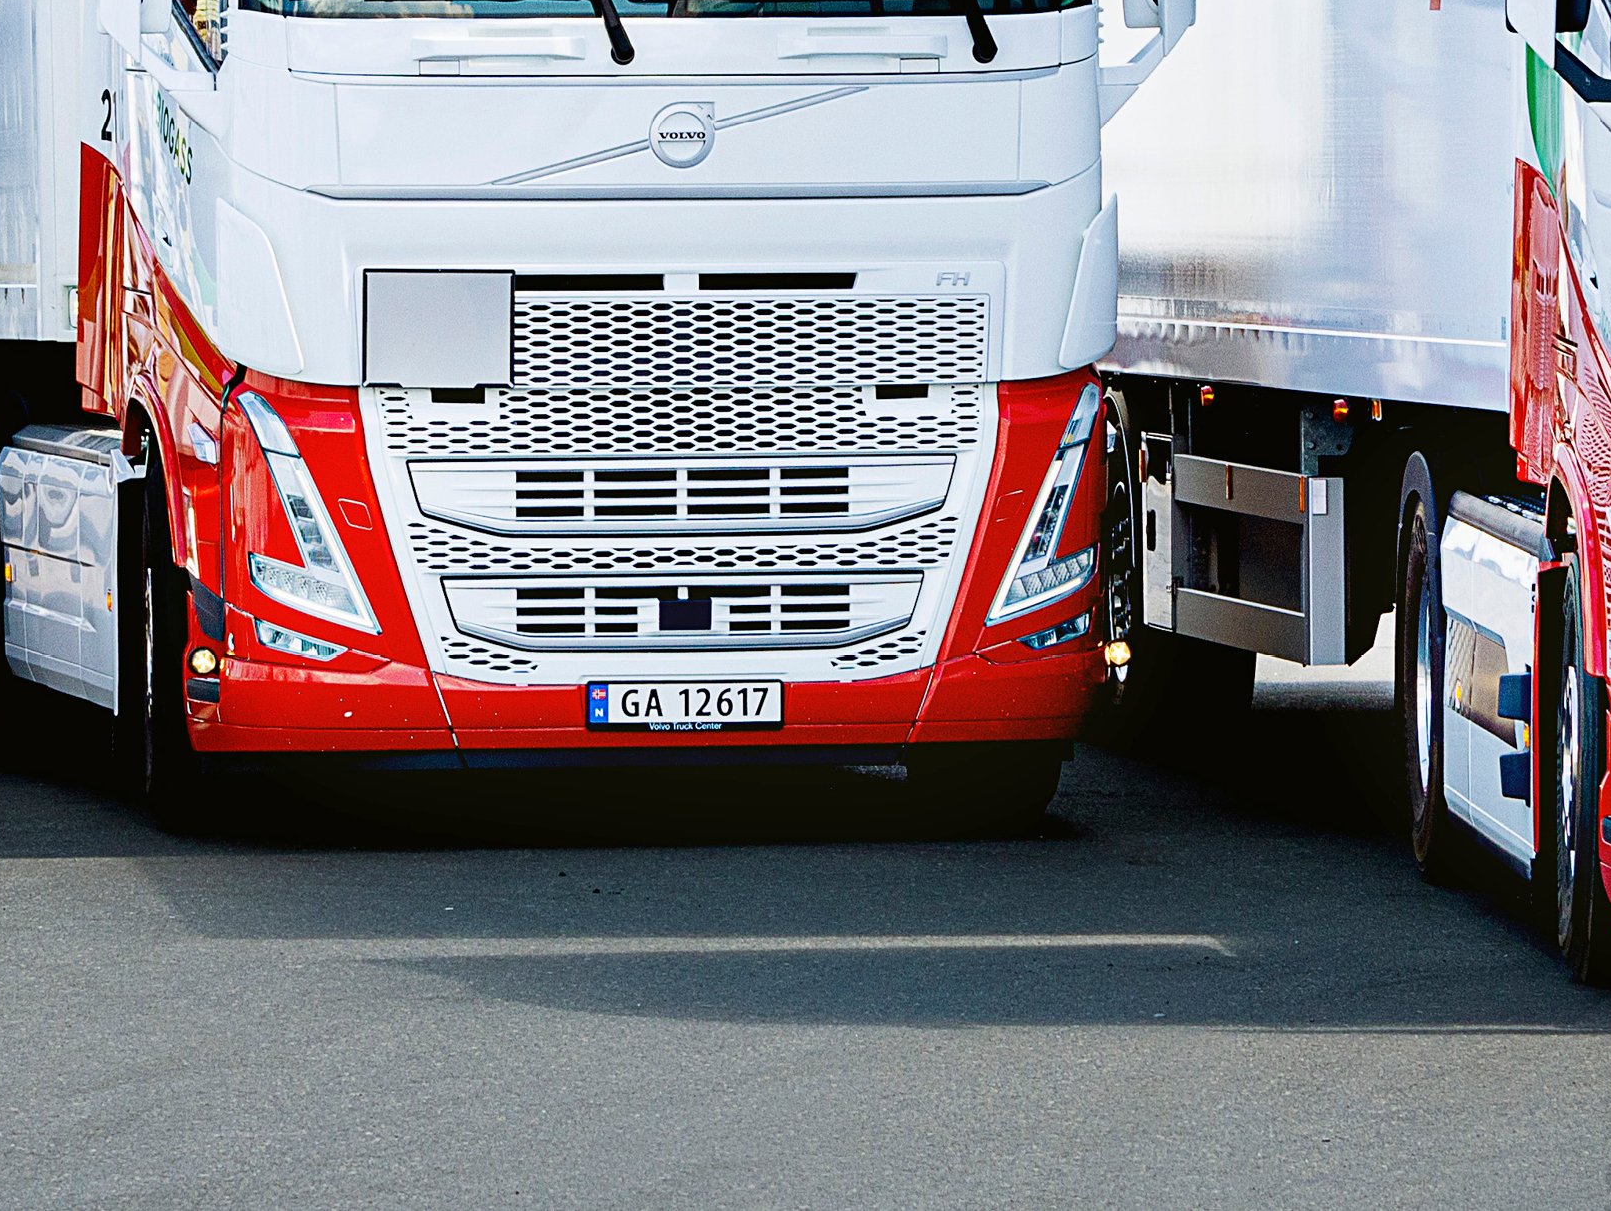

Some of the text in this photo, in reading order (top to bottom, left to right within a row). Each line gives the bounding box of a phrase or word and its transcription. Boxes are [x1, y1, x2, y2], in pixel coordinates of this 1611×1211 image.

[659, 131, 706, 139] VOLVO
[936, 271, 971, 286] FH
[621, 687, 769, 718] GA 12617
[594, 708, 604, 717] N
[649, 721, 722, 730] Volvo Truck Center
